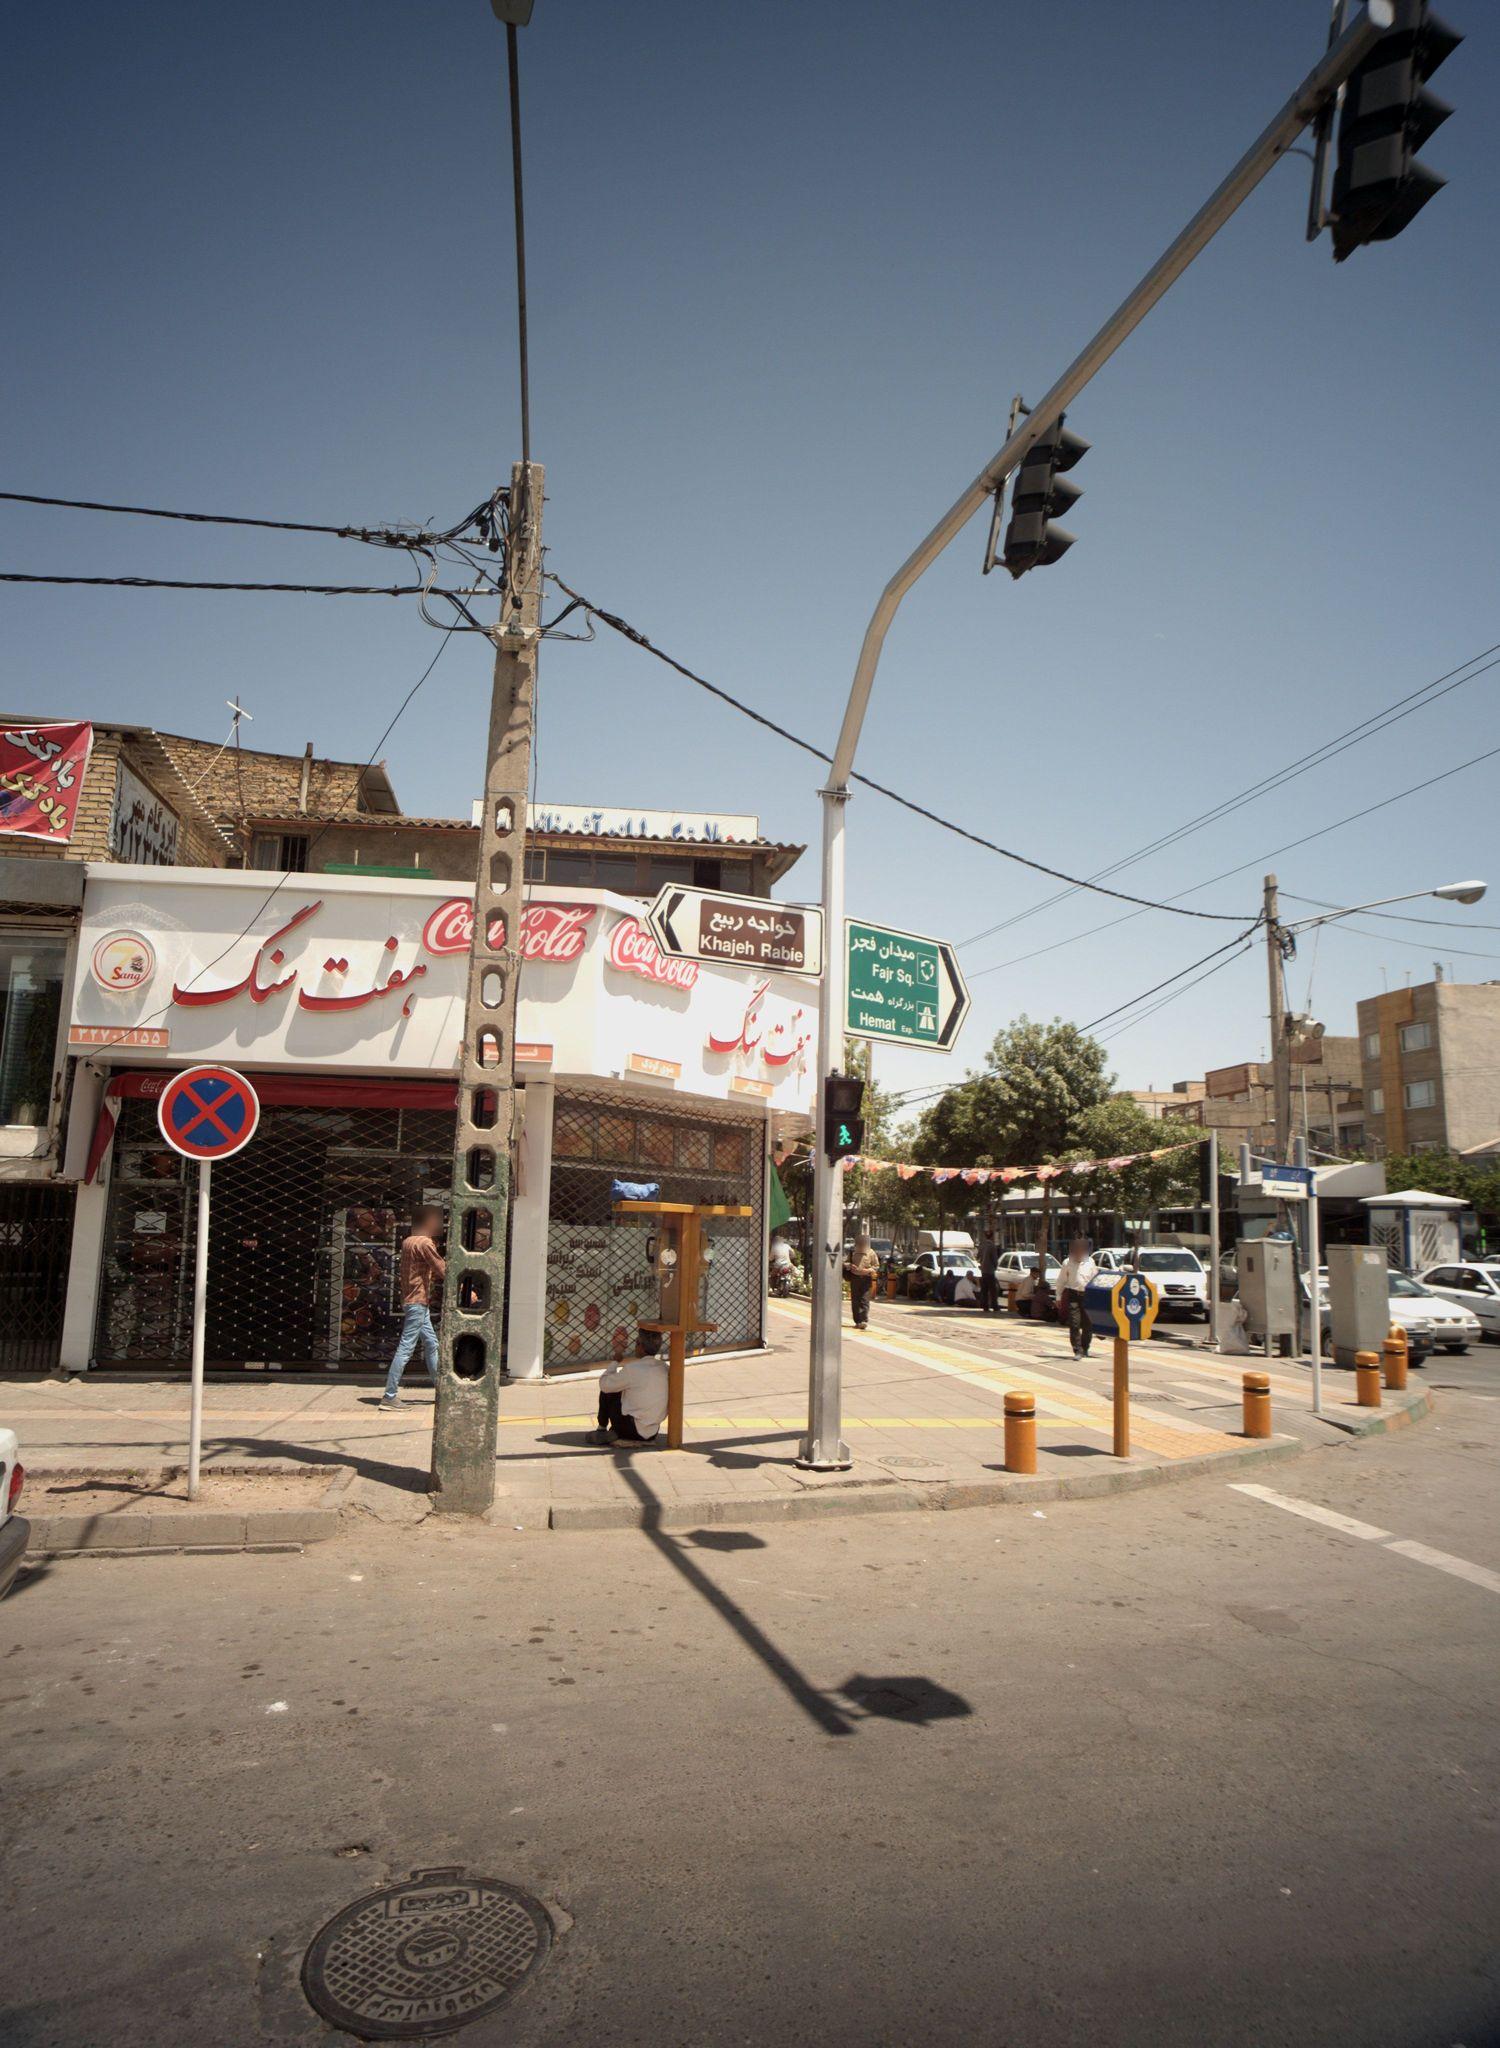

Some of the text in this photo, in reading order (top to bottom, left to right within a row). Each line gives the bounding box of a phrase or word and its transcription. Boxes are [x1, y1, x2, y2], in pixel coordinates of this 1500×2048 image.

[709, 911, 796, 940] خواجه ربیع
[172, 900, 427, 1018] هفت سنگ
[700, 934, 804, 963] Khajeh Rabie
[851, 936, 916, 962] میدان فجر
[111, 966, 142, 982] Sang
[872, 963, 915, 988] Fajr Sq.
[851, 987, 915, 1012] بزرگراه همت
[859, 1011, 897, 1031] Hemat
